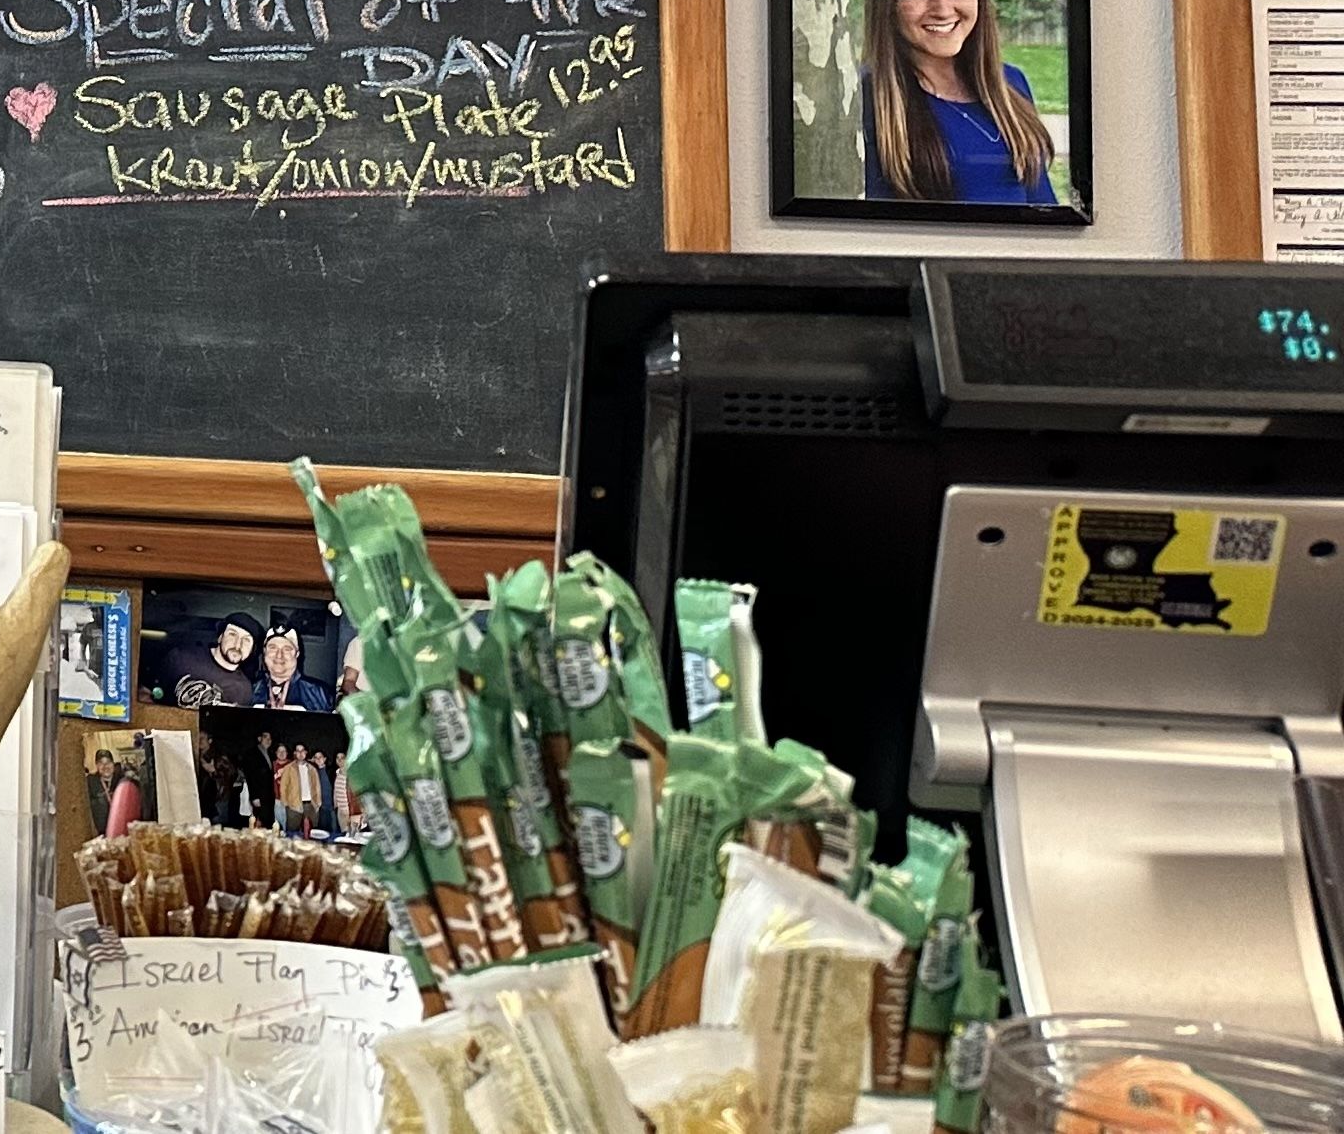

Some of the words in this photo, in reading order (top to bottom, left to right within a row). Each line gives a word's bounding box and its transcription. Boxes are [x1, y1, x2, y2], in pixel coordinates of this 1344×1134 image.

[341, 33, 536, 91] DAY
[75, 76, 356, 150] Sausage
[382, 79, 550, 141] Plate
